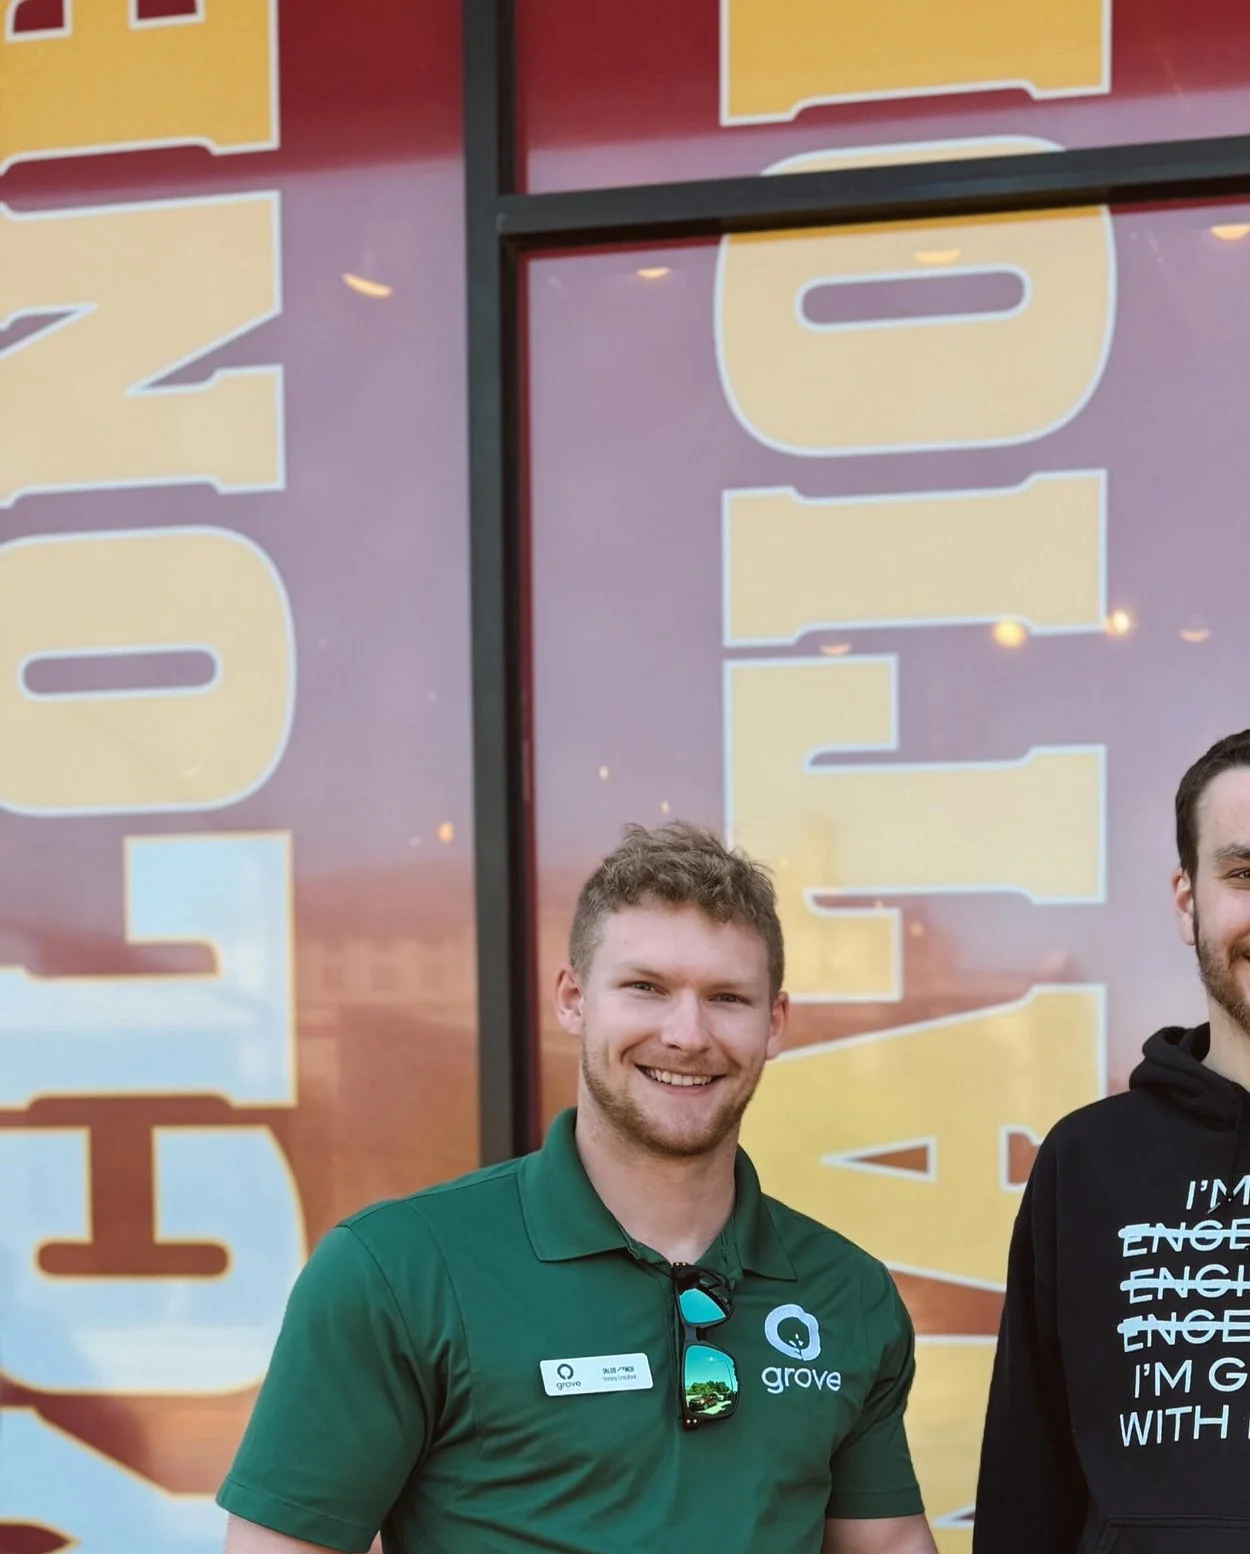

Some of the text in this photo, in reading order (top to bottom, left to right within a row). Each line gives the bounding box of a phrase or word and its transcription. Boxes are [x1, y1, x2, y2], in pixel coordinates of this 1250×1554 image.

[556, 1380, 582, 1391] grove
[761, 1366, 842, 1394] grove
[1134, 1359, 1193, 1399] I'M
[1119, 1404, 1230, 1448] WITH
